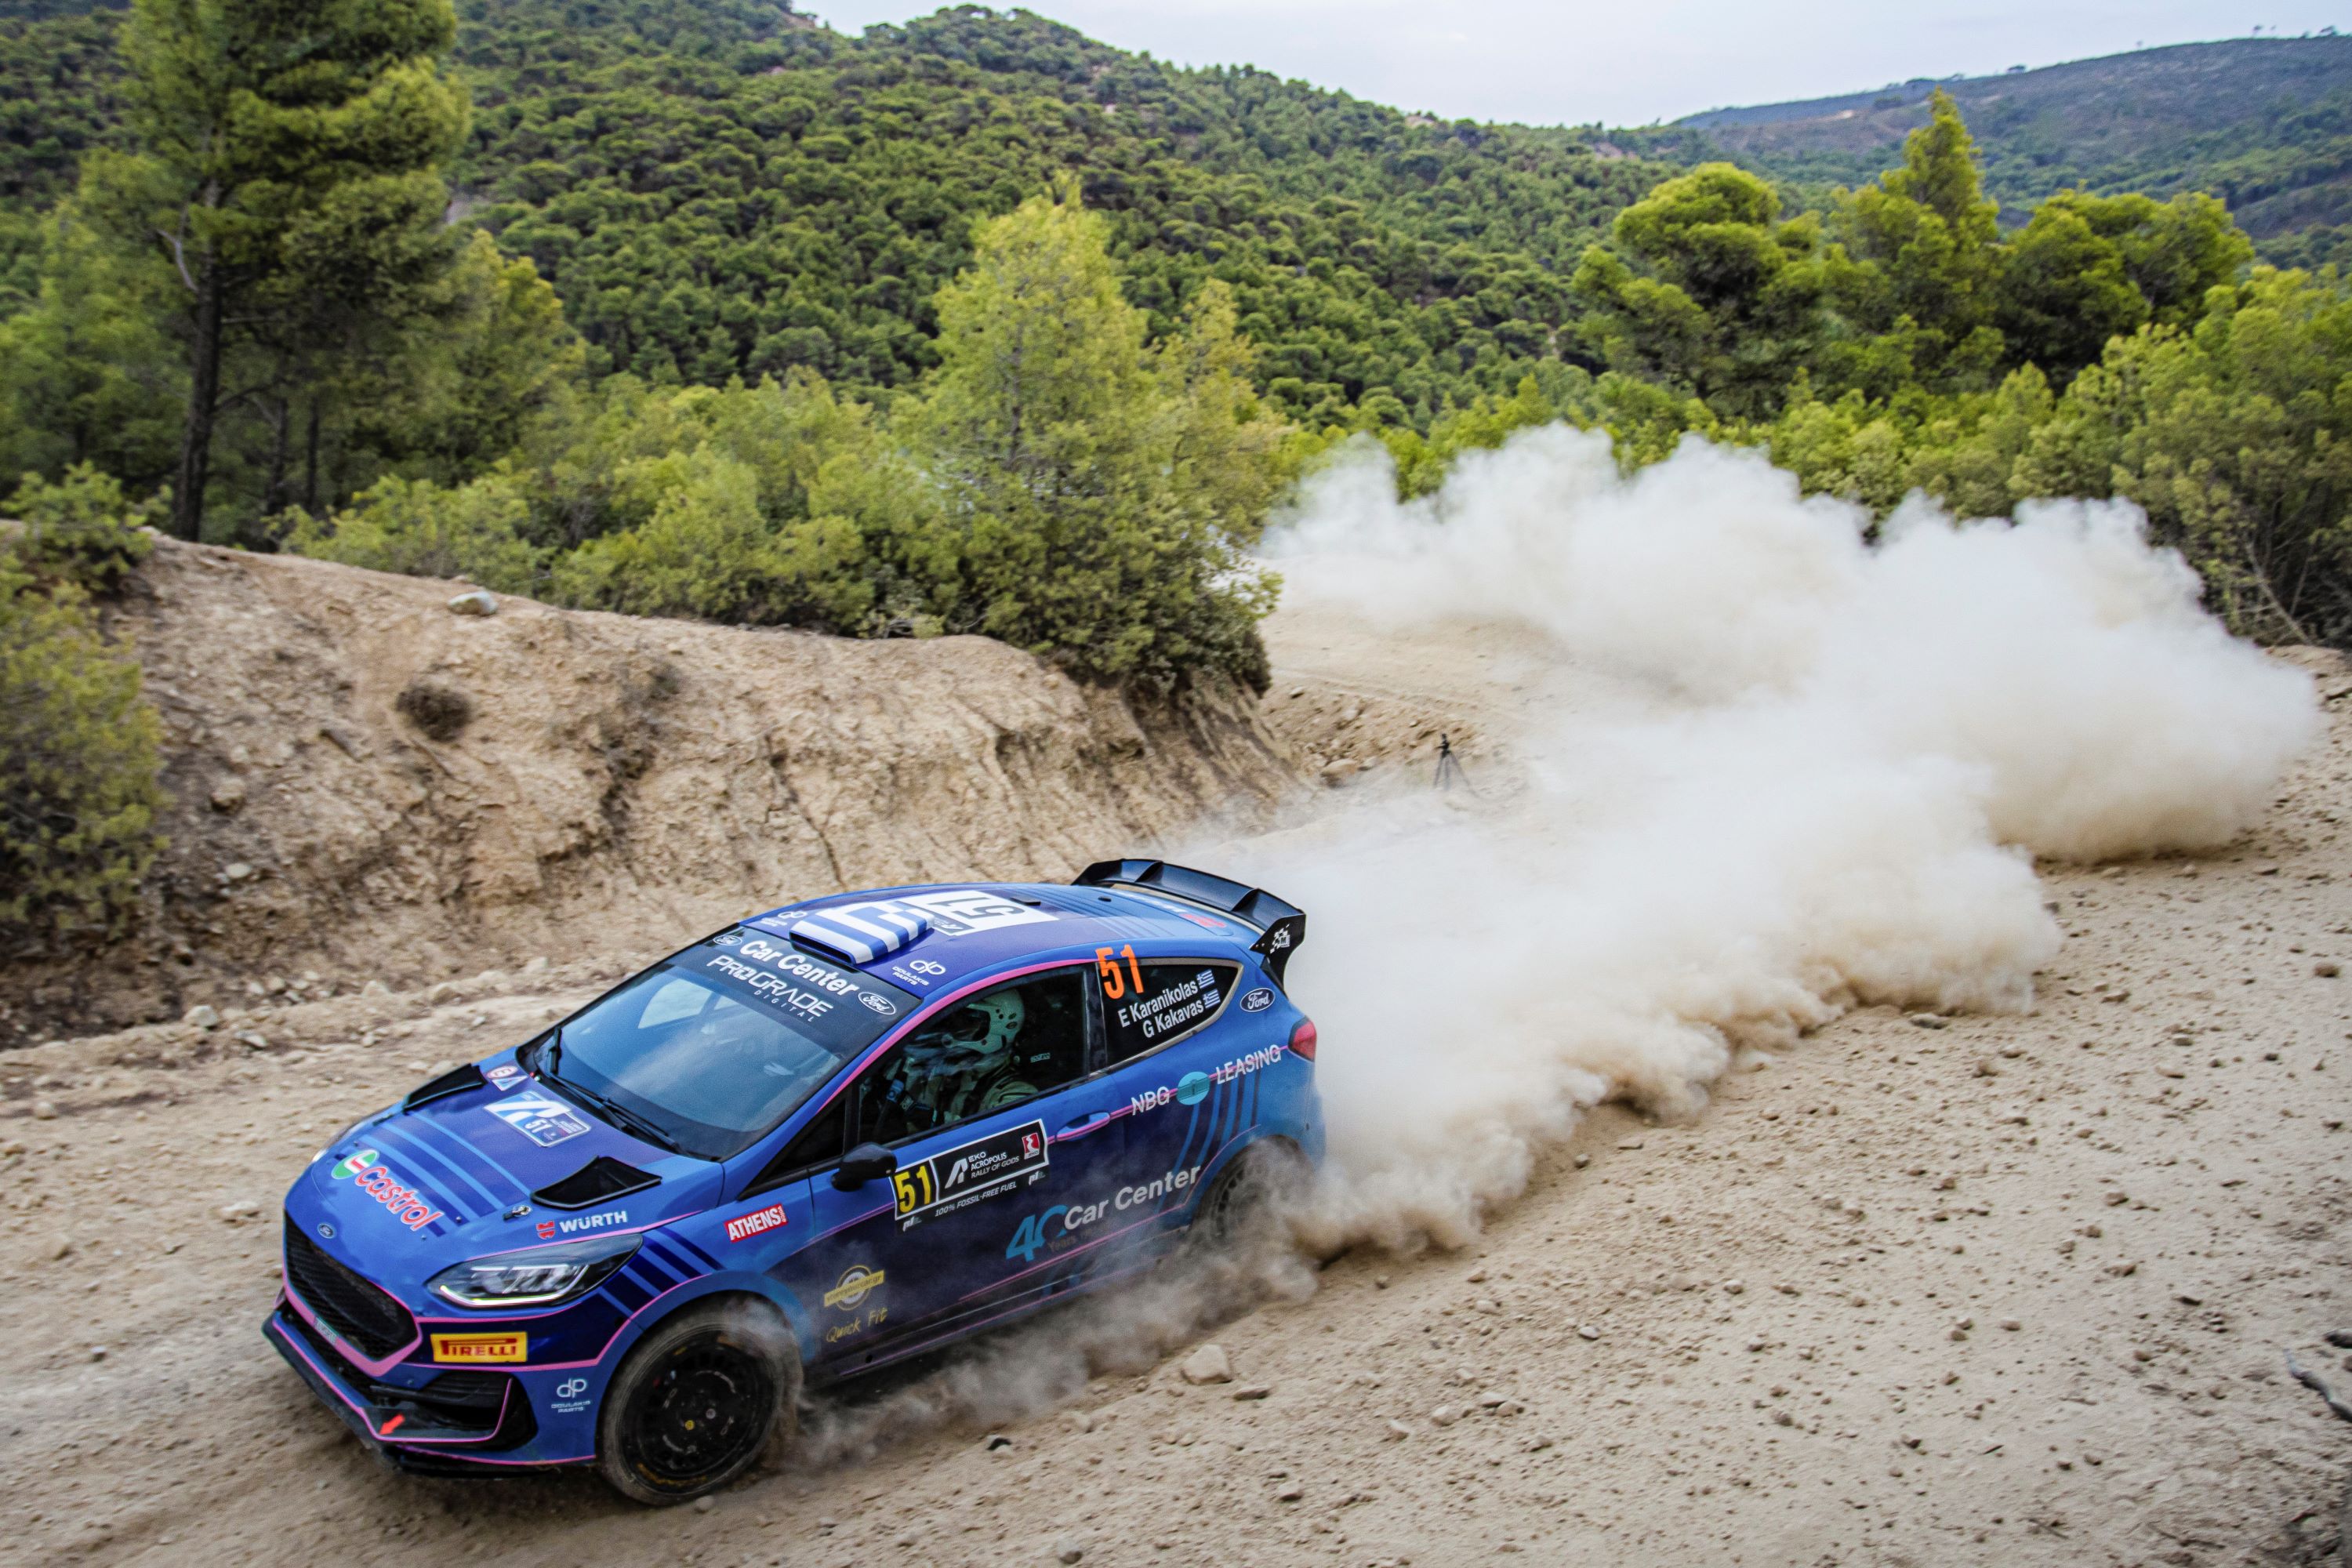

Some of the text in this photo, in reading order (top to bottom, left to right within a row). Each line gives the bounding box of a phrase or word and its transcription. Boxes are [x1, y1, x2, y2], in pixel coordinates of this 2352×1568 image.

[927, 897, 1025, 920] 51
[739, 940, 860, 996] Car Center
[1095, 944, 1144, 1000] 51
[706, 955, 833, 1017] PROGRADE
[861, 993, 891, 1012] Ford
[1245, 989, 1270, 1010] Ford
[753, 989, 816, 1022] DIGITAL
[1117, 979, 1200, 1028] E Karanikolas
[1142, 999, 1204, 1039] G Kakavas
[1131, 1044, 1282, 1116] NBG LEASING
[968, 1151, 986, 1163] EKO
[971, 1152, 1007, 1171] ACROPOLIS
[971, 1156, 1019, 1178] RALLY OF GODS
[355, 1166, 445, 1232] Castrol
[894, 1165, 931, 1213] 51
[935, 1181, 1017, 1217] 100% FOSSIL-FREE FUEL
[1064, 1199, 1109, 1230] Car
[1115, 1165, 1201, 1210] Center
[560, 1210, 627, 1233] WÜRTH
[728, 1208, 781, 1240] ATHENS
[826, 1316, 861, 1343] Quick
[439, 1338, 517, 1356] PIRELLI
